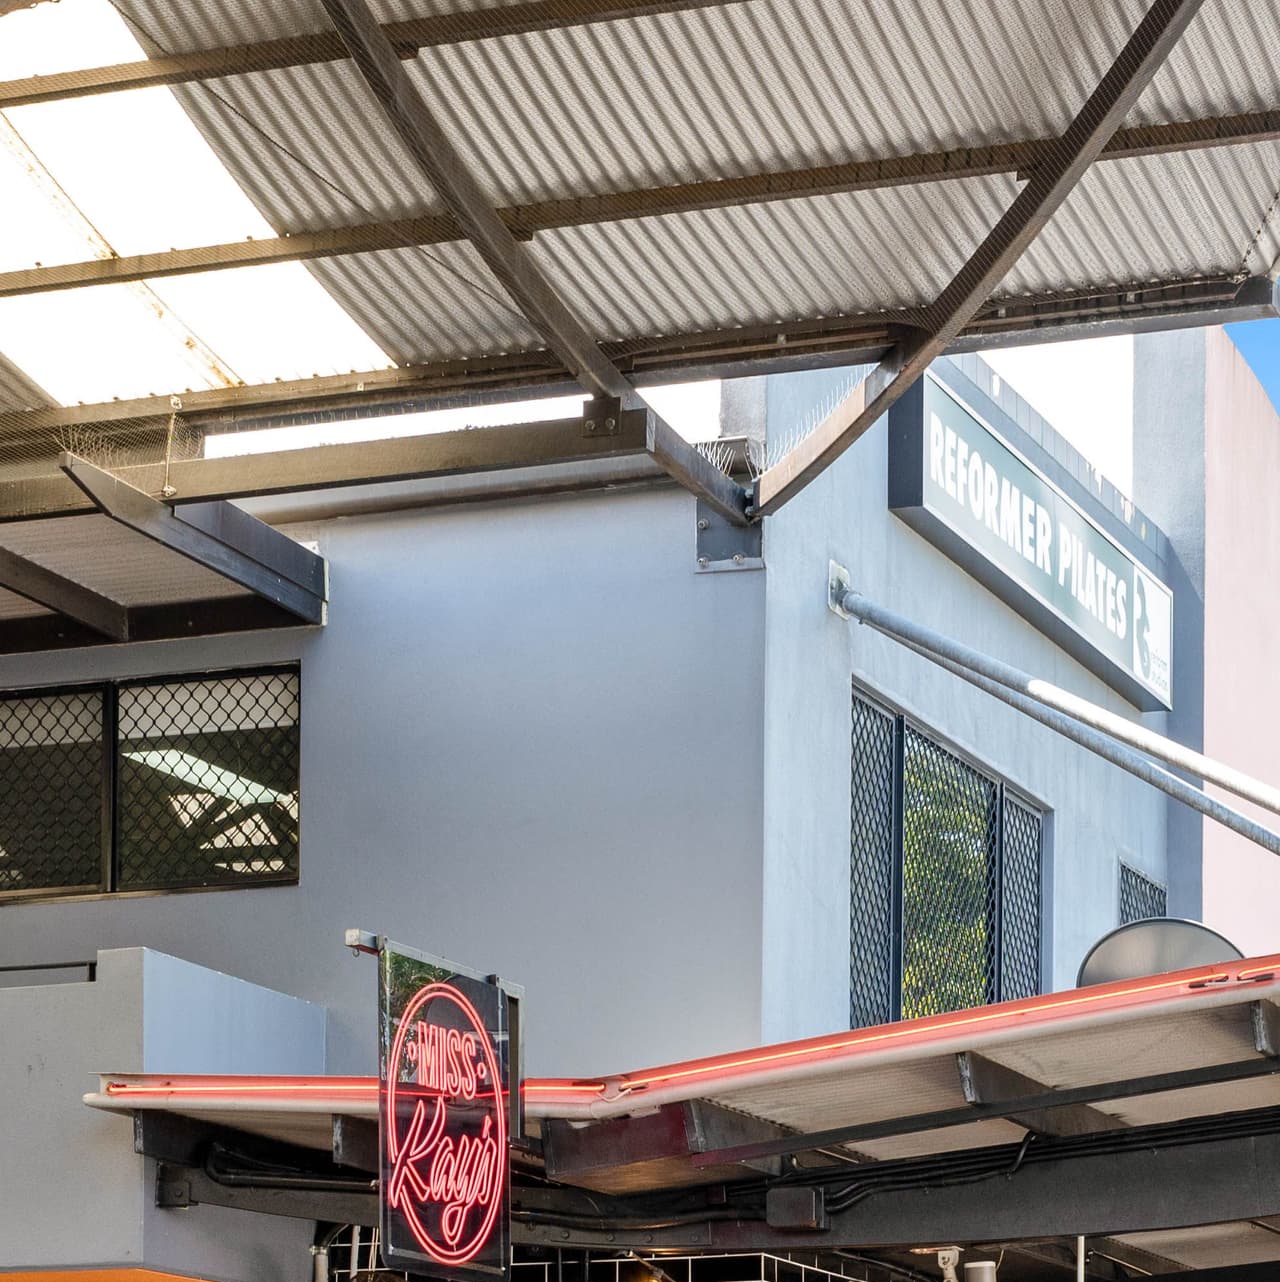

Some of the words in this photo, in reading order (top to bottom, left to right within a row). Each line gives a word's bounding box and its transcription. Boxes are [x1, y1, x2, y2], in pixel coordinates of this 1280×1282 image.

[930, 411, 1052, 575] REFORMER
[1059, 522, 1127, 640] PILATES
[418, 1021, 477, 1100] MISS
